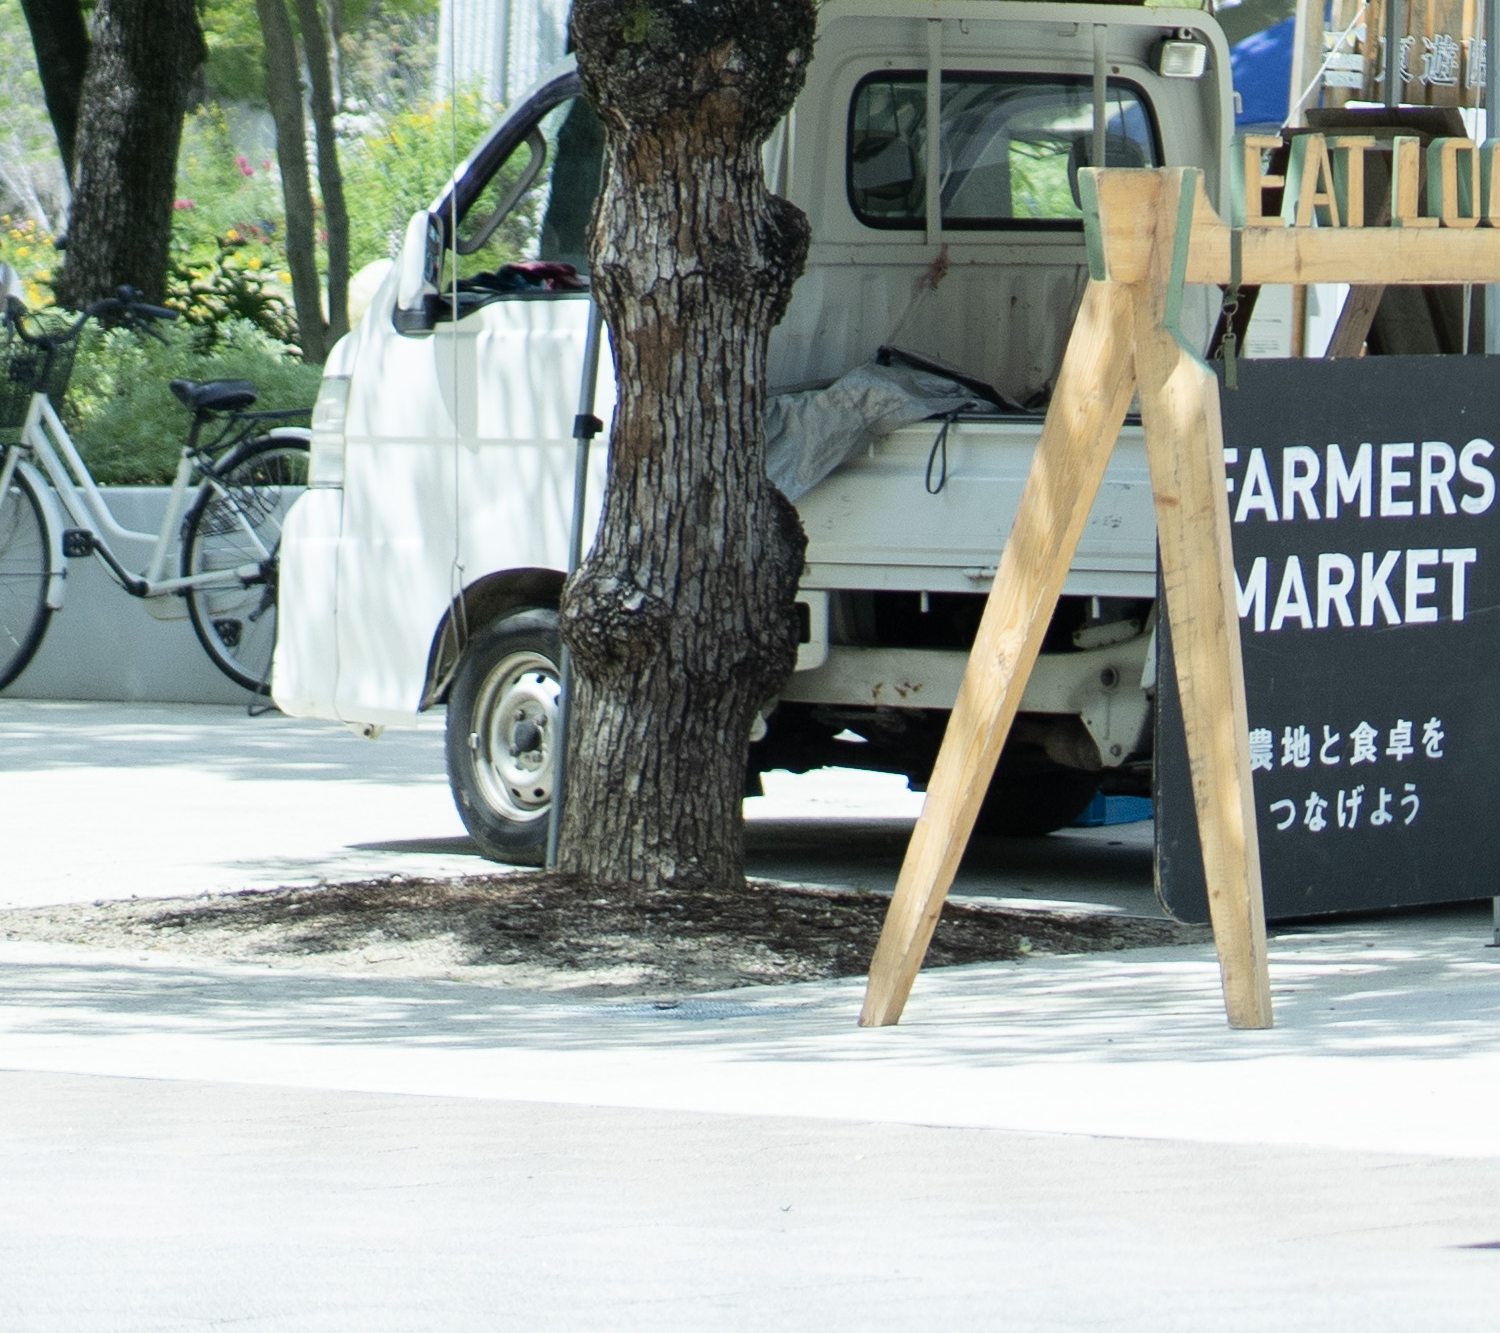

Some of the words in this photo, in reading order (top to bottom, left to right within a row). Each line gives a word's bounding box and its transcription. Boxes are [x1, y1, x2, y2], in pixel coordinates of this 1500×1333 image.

[1243, 133, 1377, 229] EAT
[1233, 548, 1477, 633] MARKET
[1249, 717, 1445, 771] 農地と食卓を
[1269, 783, 1421, 832] つなげよう
